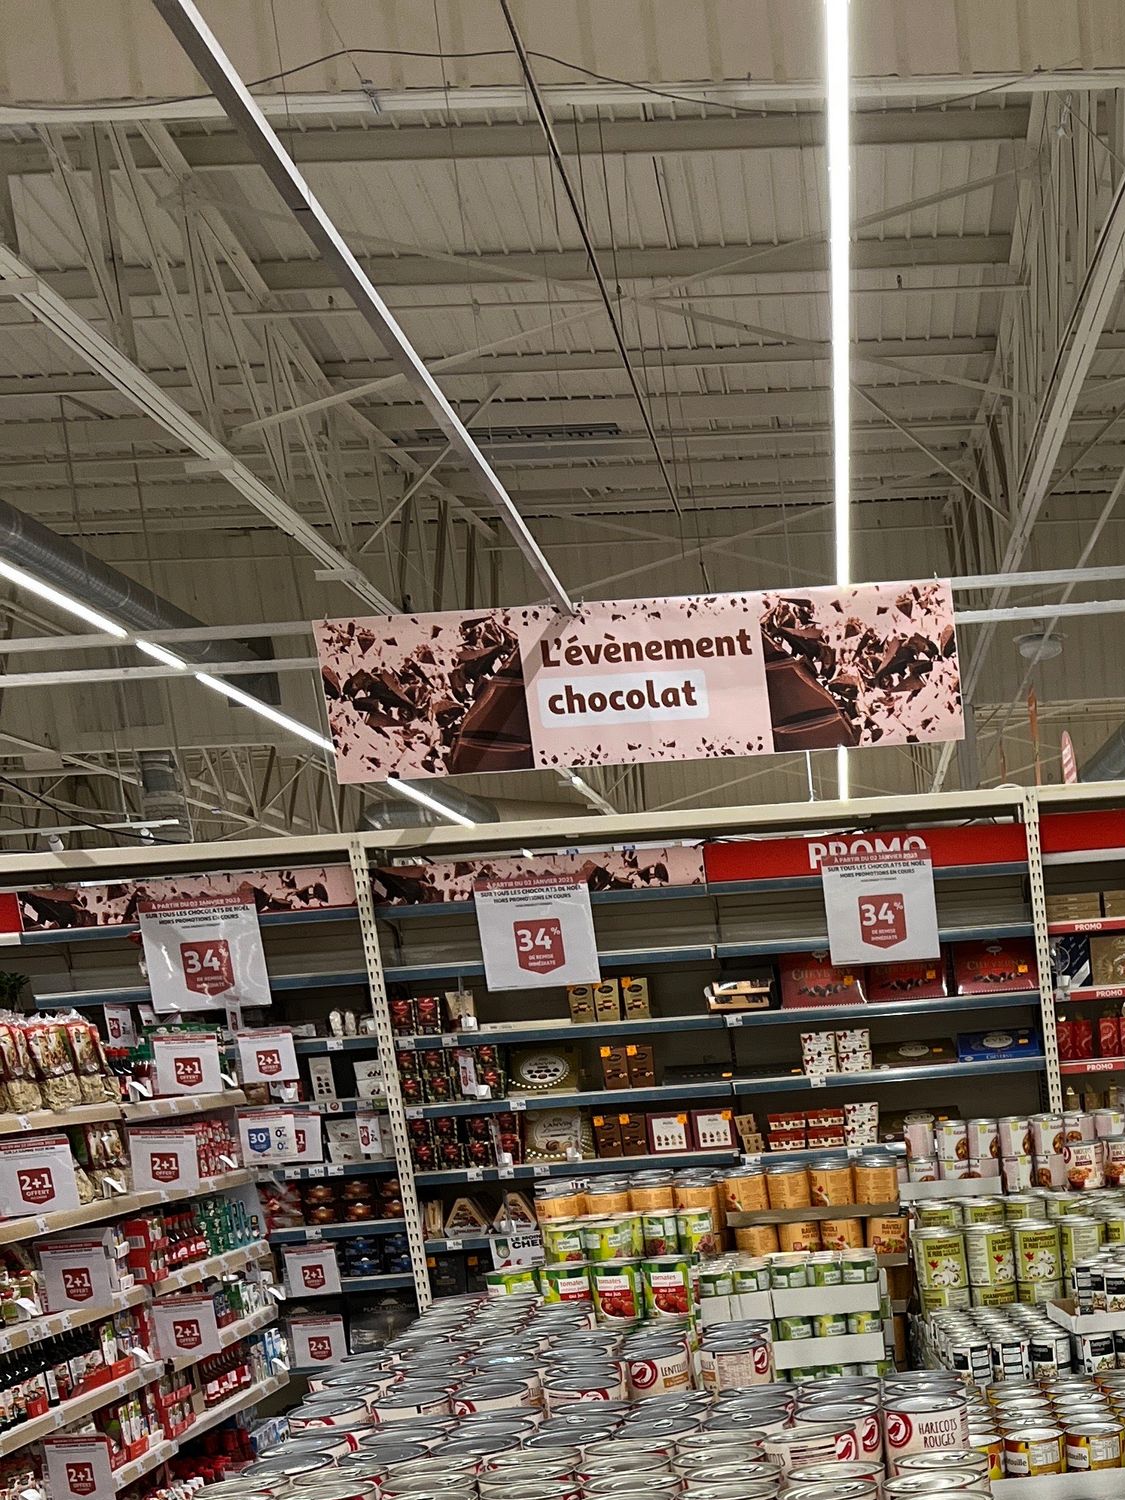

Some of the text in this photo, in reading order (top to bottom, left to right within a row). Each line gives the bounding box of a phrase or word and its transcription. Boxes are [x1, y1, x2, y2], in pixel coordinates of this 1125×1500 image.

[539, 628, 753, 668] L'évènement
[547, 678, 698, 716] chocolat
[257, 1054, 281, 1067] 2+1
[152, 1154, 178, 1170] 2+1
[19, 1174, 54, 1190] 2+1
[26, 1189, 51, 1197] OFFERT
[918, 1418, 958, 1434] HARICOTS
[923, 1433, 956, 1448] ROUGES
